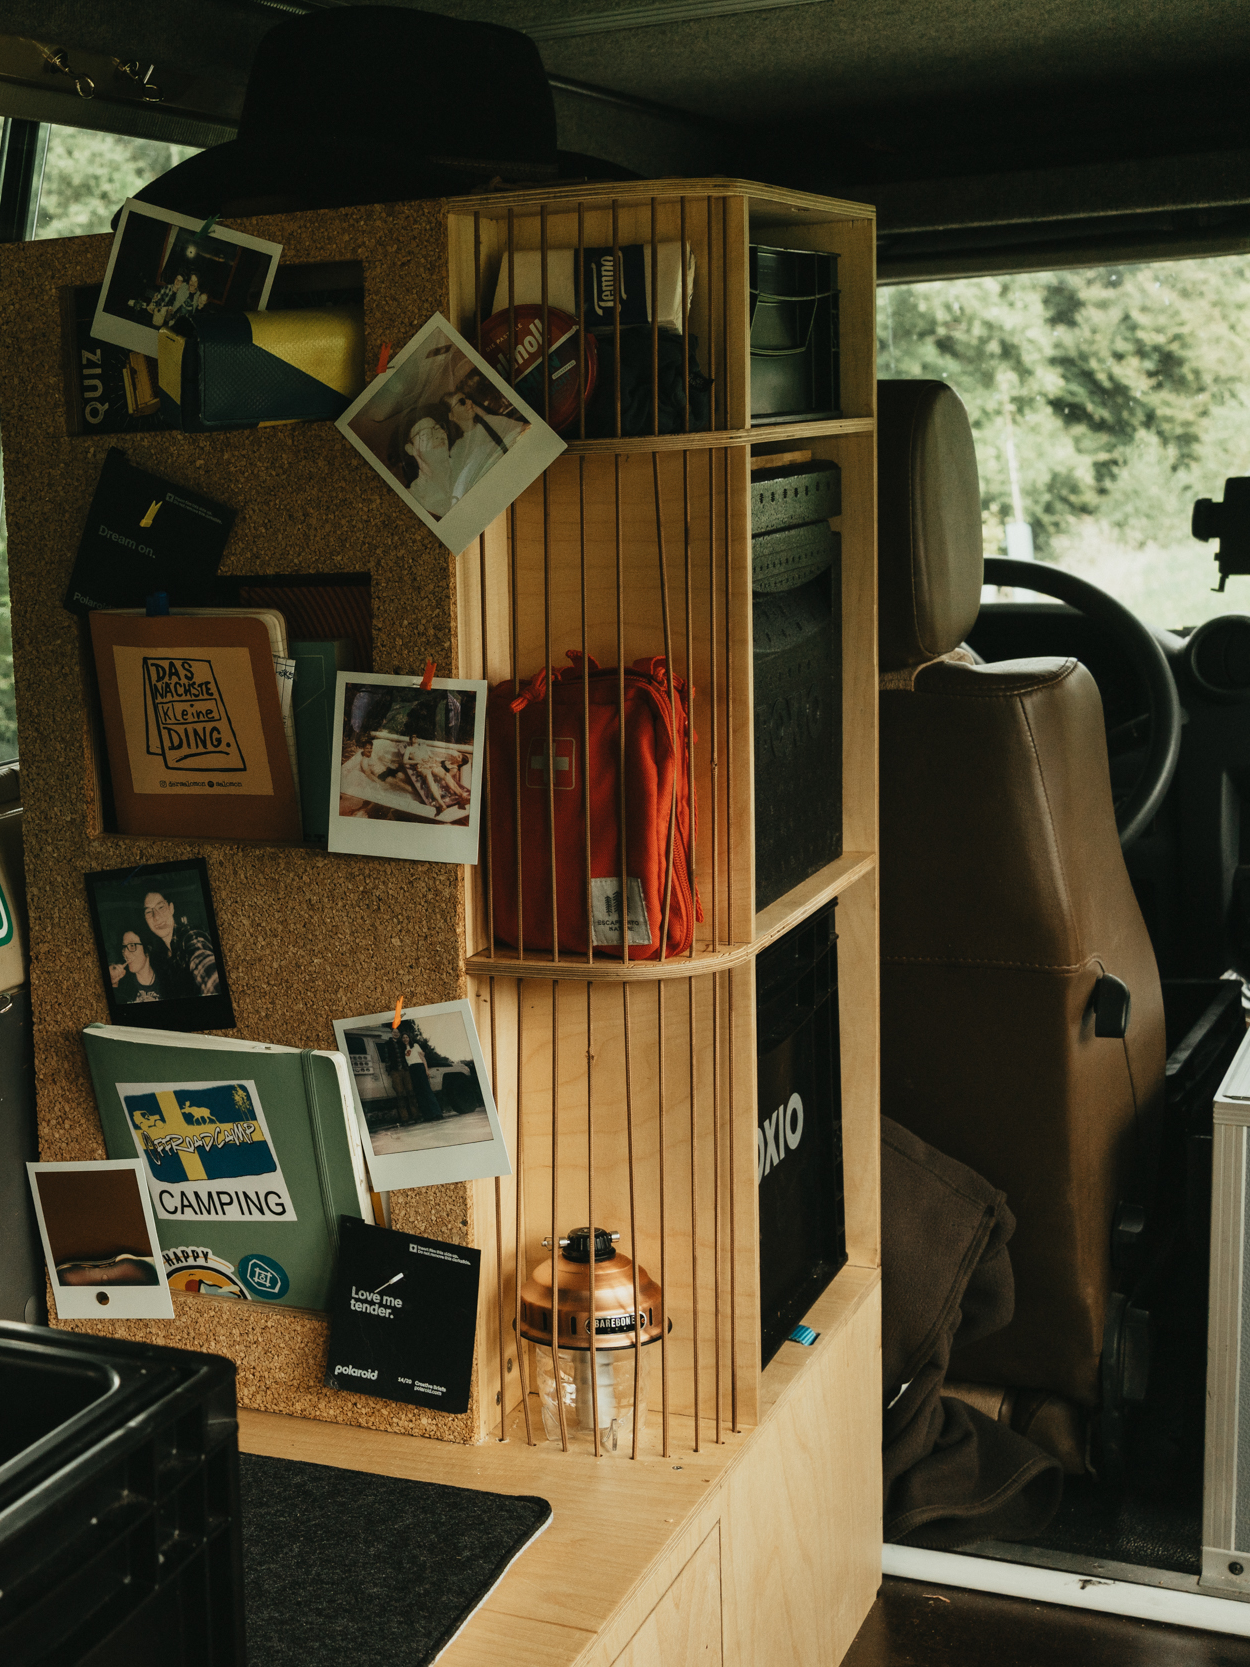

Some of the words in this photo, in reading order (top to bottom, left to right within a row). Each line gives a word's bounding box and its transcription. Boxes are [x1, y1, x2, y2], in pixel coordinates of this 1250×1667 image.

[485, 342, 498, 353] DIE
[81, 348, 109, 425] QUIZ
[98, 524, 136, 550] Dream
[137, 544, 156, 559] on.
[150, 661, 194, 683] DAS
[153, 681, 214, 700] NÄCHSTE
[162, 726, 231, 751] DING.
[159, 1189, 287, 1216] CAMPING
[162, 1249, 209, 1267] HAPPY
[351, 1285, 381, 1303] Love
[382, 1295, 403, 1308] me
[350, 1298, 394, 1319] tender.
[334, 1364, 379, 1381] polaroid
